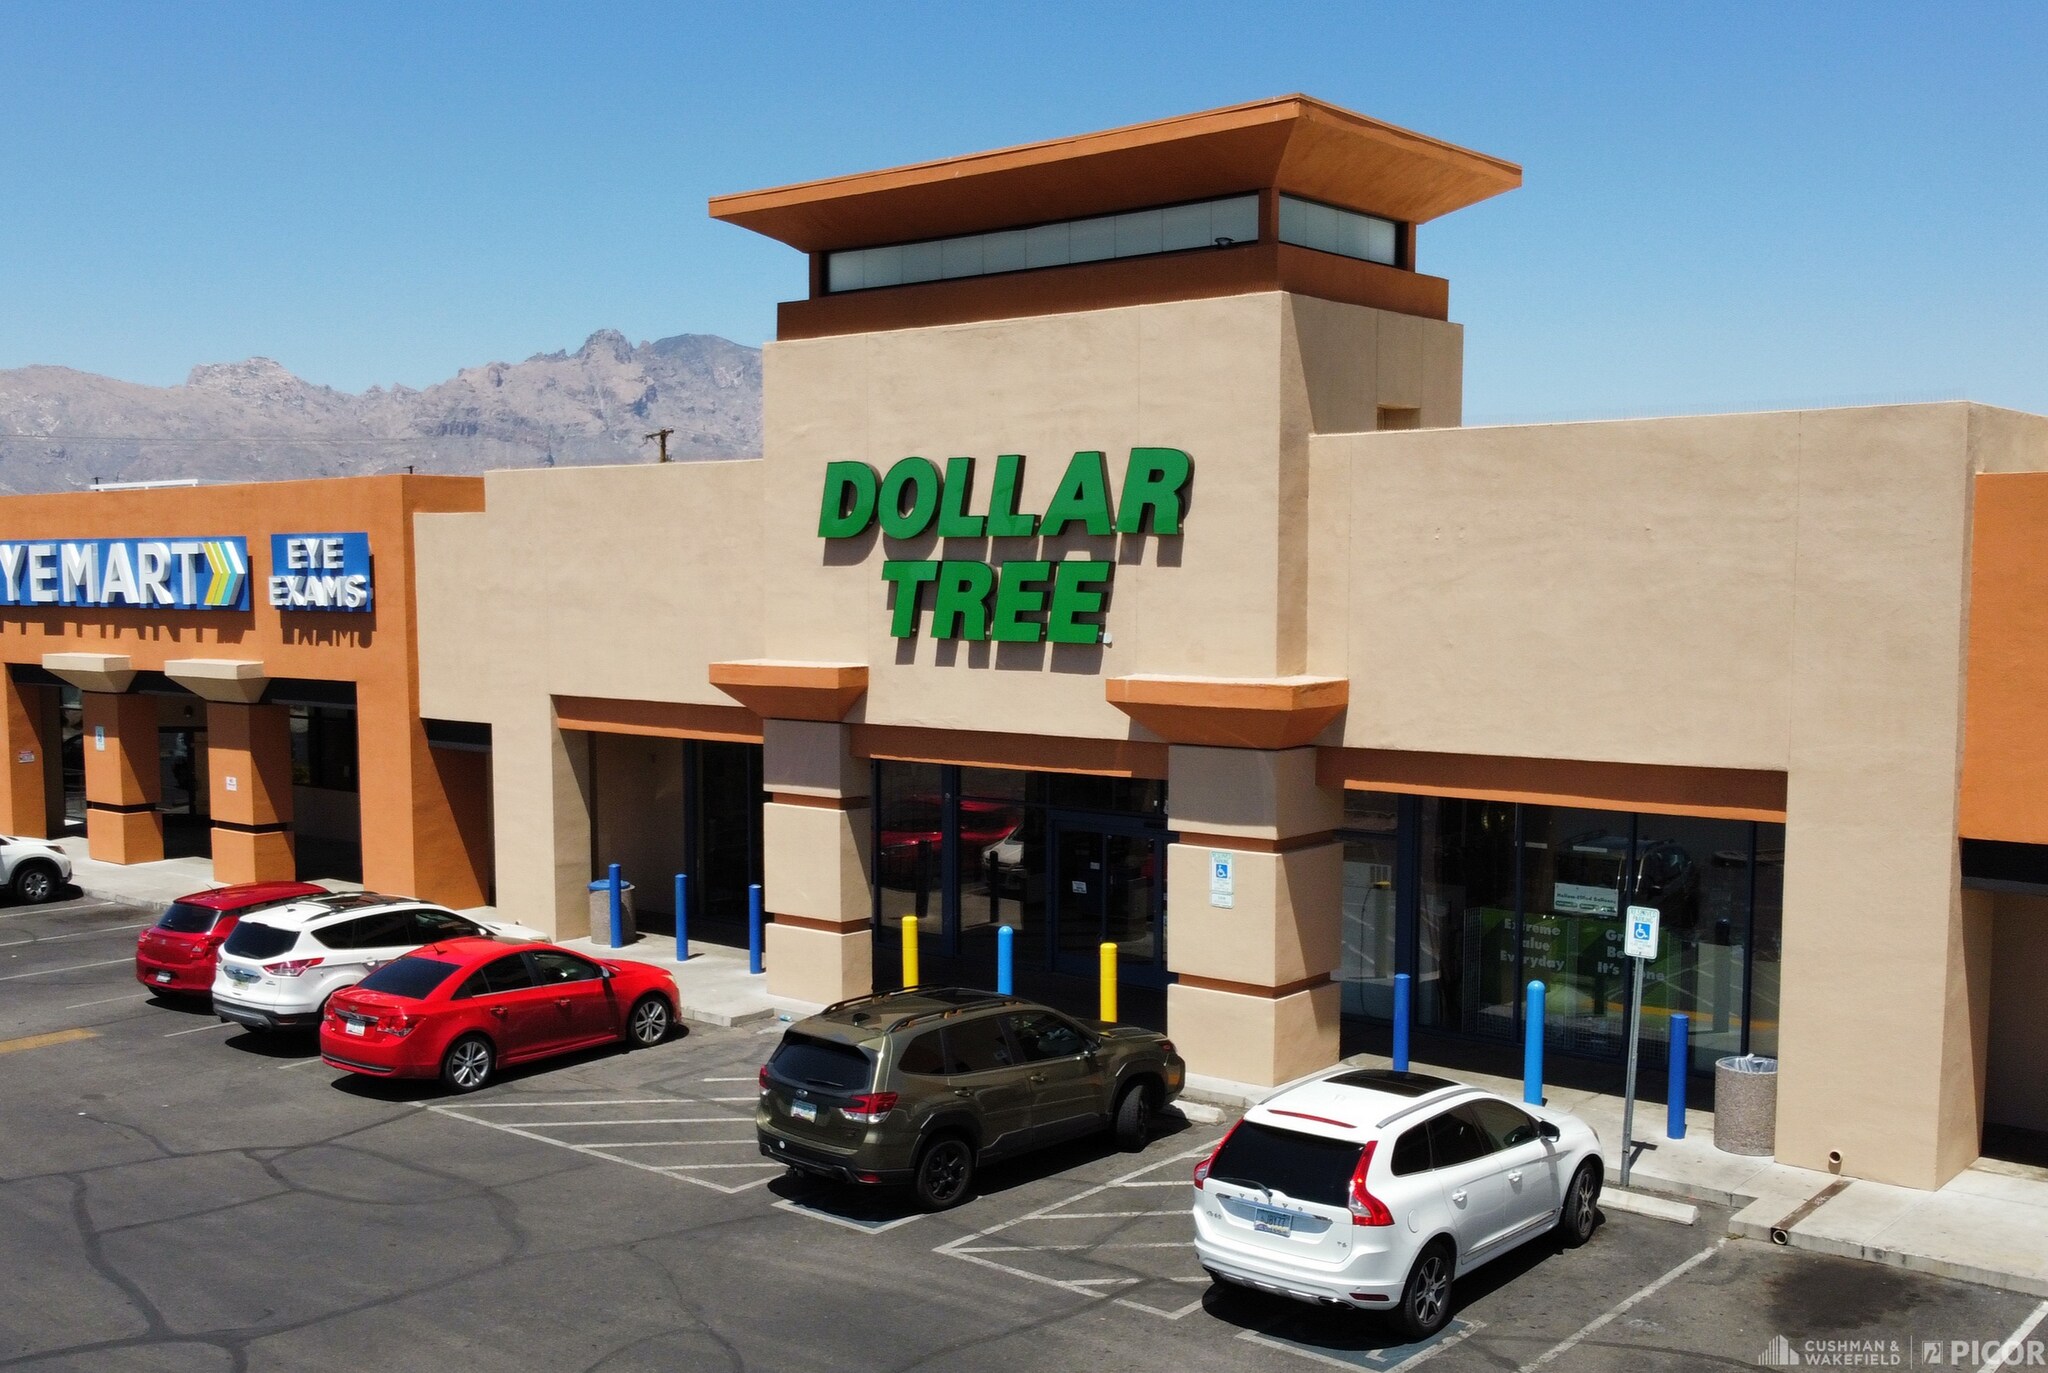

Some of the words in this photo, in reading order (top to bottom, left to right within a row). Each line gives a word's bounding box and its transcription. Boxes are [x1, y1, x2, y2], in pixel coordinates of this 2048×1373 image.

[818, 447, 1194, 540] DOLLAR
[287, 538, 345, 569] EYE
[0, 542, 202, 605] YEMART
[268, 575, 367, 608] EXAMS
[881, 560, 1111, 644] TREE
[1512, 935, 1551, 951] alue
[1500, 950, 1565, 972] Evryday
[1597, 961, 1621, 976] It's
